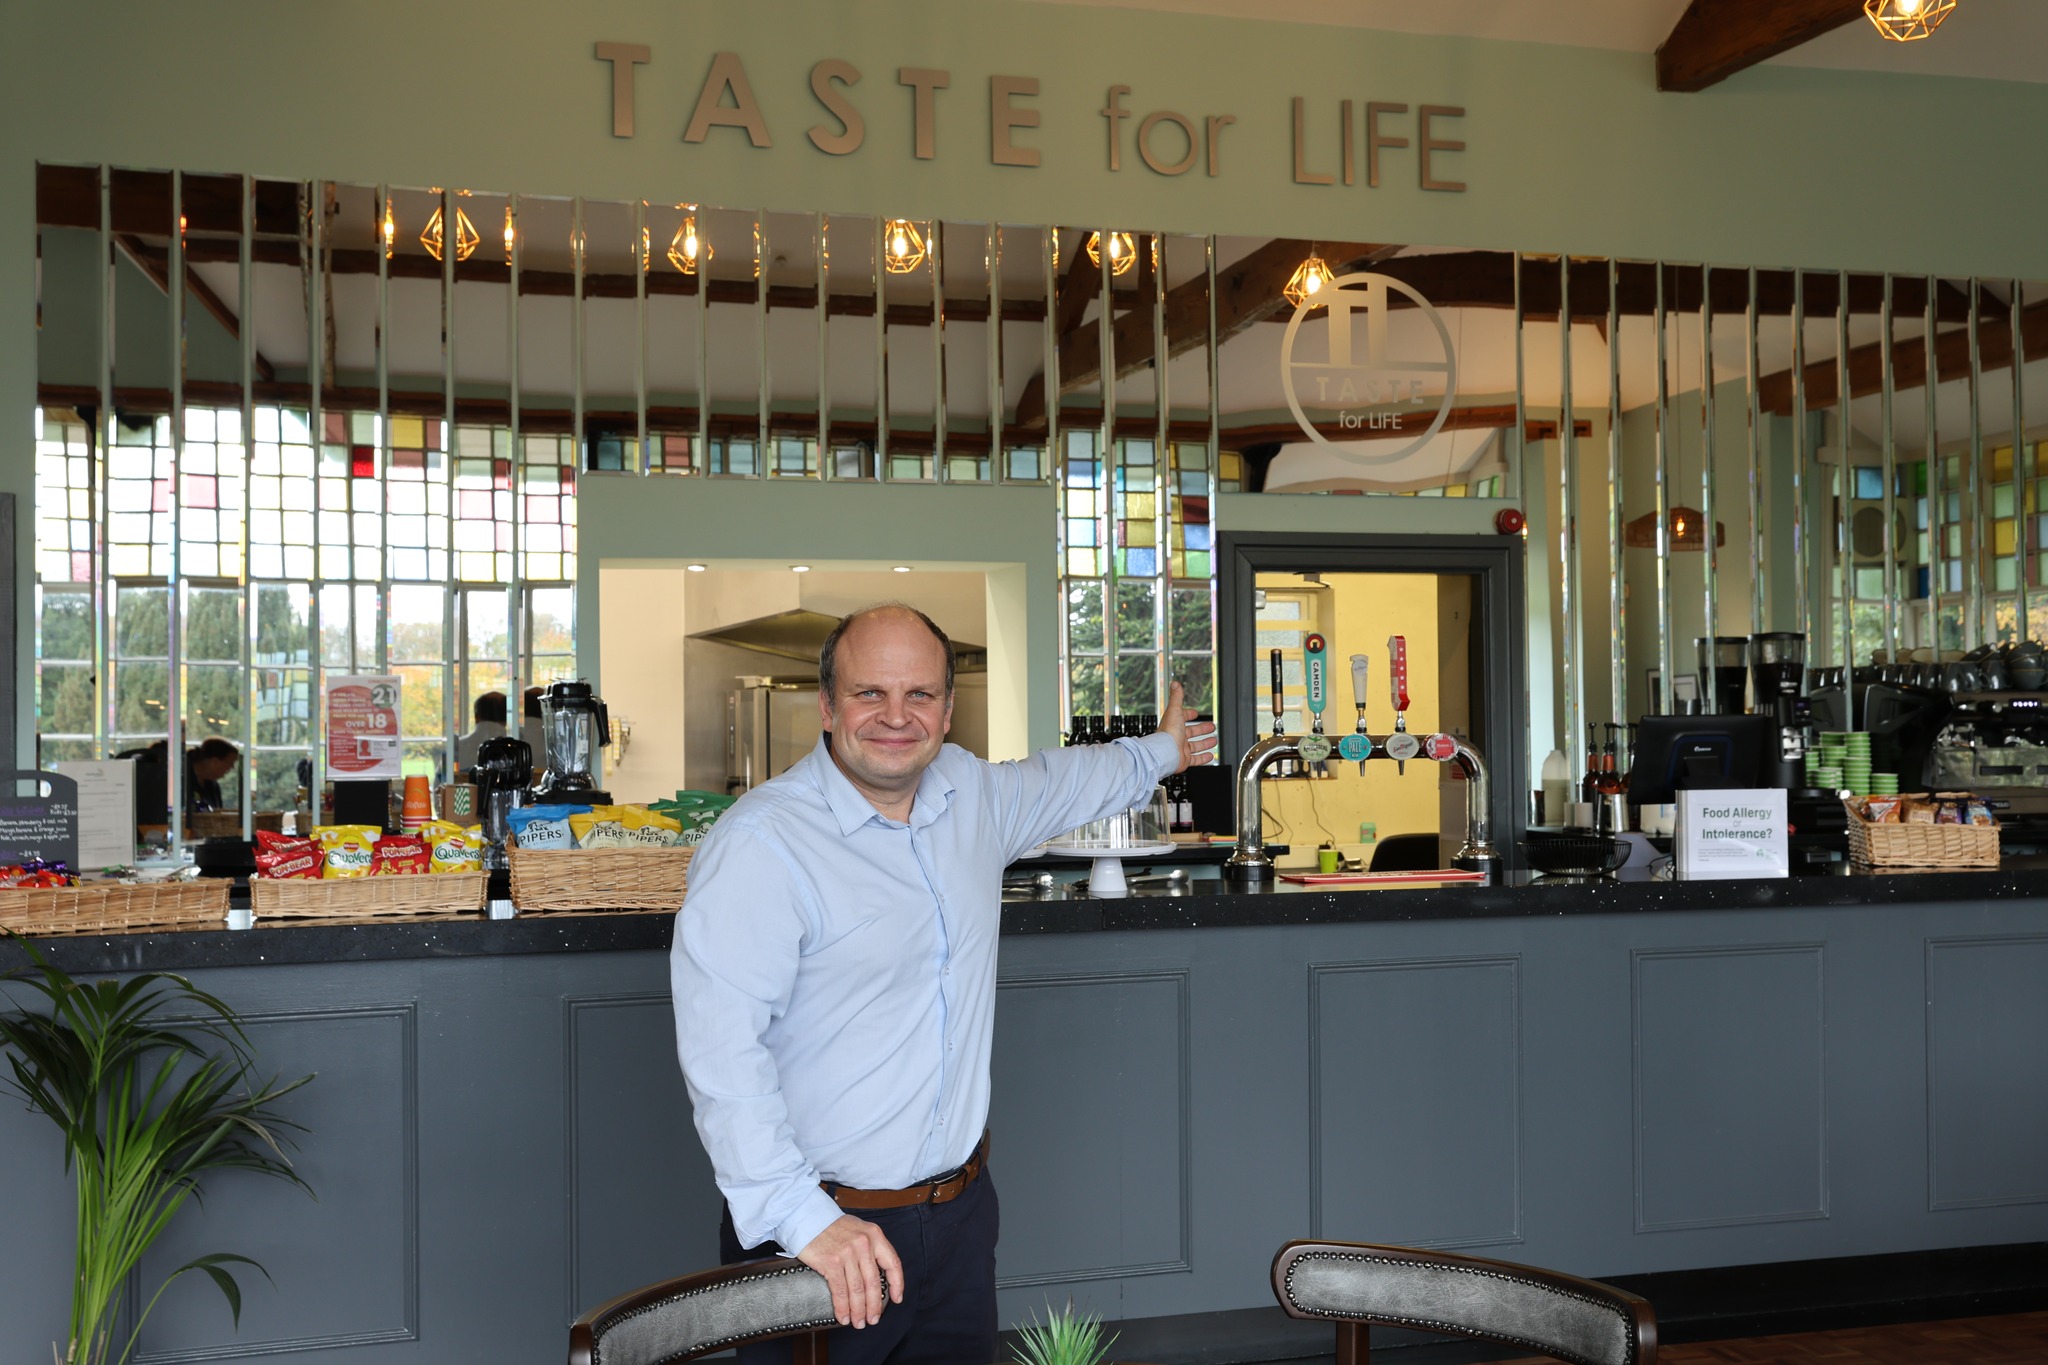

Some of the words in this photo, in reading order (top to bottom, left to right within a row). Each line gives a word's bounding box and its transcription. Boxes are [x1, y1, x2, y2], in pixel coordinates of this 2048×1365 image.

[595, 41, 1042, 168] TASTE
[1100, 83, 1237, 177] for
[1291, 95, 1468, 193] LIFE
[1316, 376, 1424, 404] TASTE
[1339, 410, 1364, 429] for
[1369, 412, 1402, 430] LIFE
[372, 687, 395, 705] 21
[345, 720, 366, 728] OVER
[366, 713, 388, 729] 18
[1348, 741, 1362, 753] PALE
[1703, 807, 1730, 818] Food
[1732, 807, 1772, 820] Allergy
[1733, 820, 1742, 828] or
[519, 829, 562, 845] PIPERS
[628, 831, 669, 845] PIPERS
[685, 833, 704, 842] PIP
[1702, 828, 1773, 839] Intolerance?
